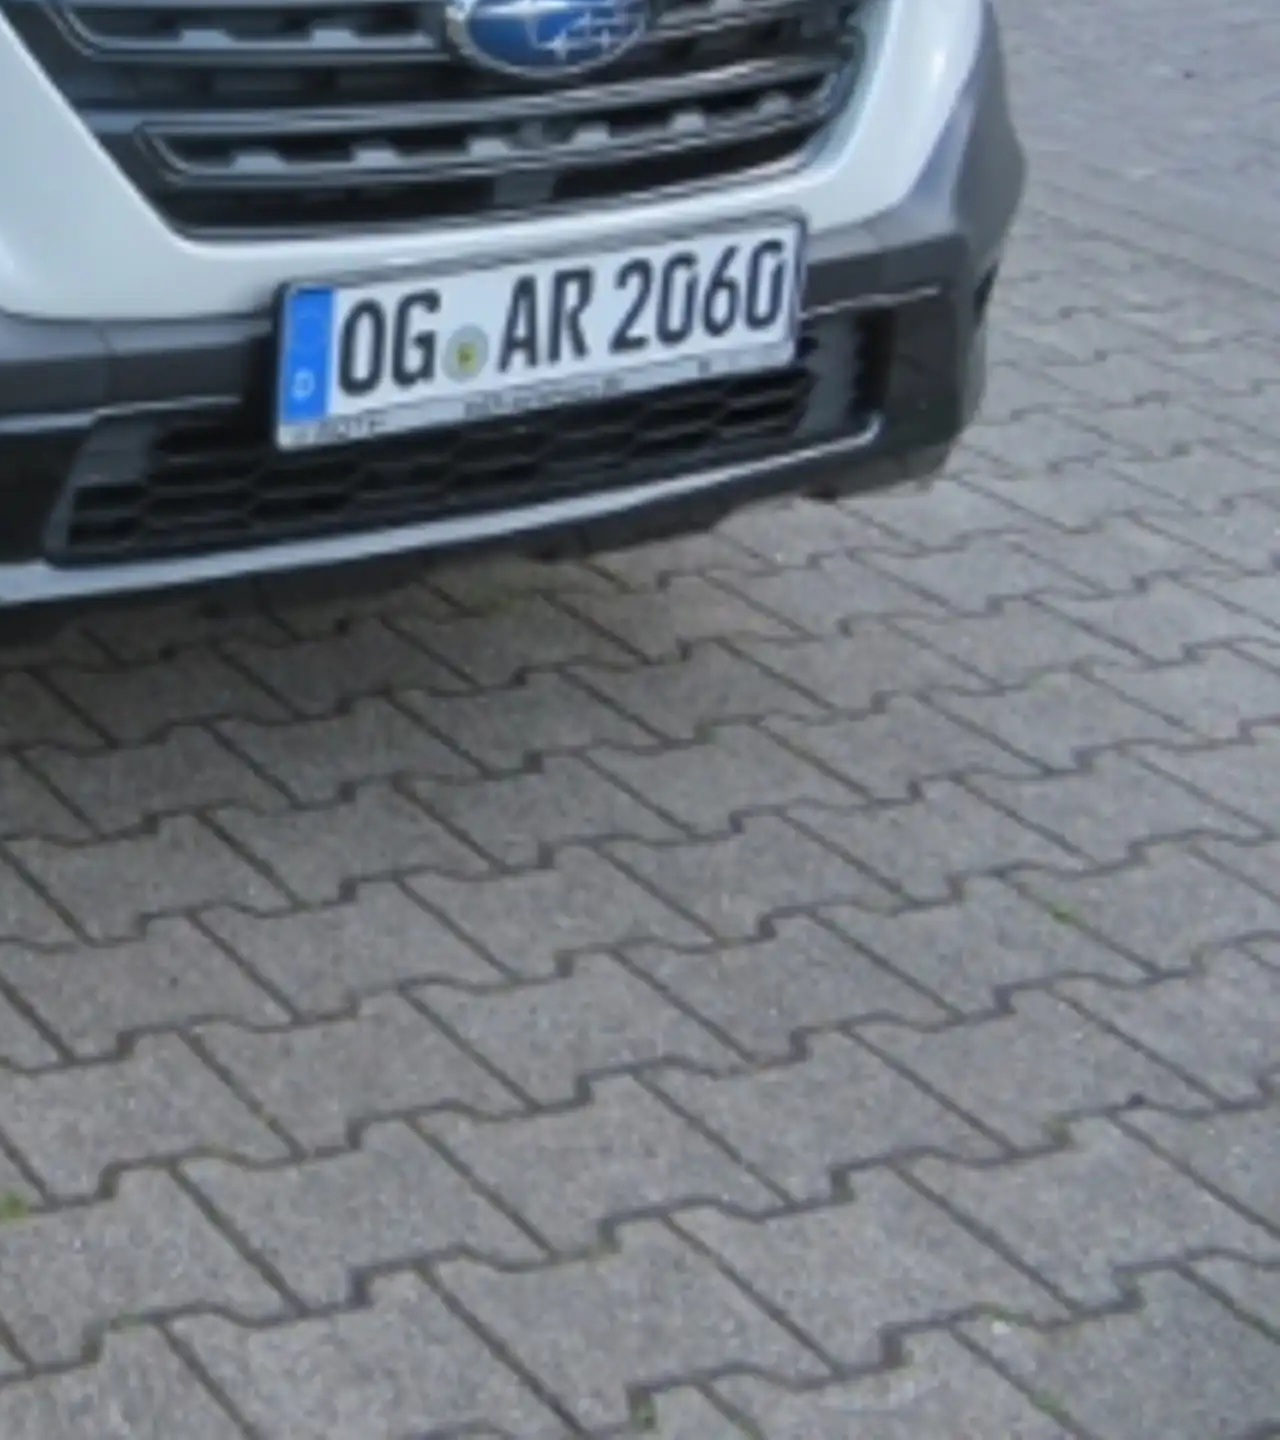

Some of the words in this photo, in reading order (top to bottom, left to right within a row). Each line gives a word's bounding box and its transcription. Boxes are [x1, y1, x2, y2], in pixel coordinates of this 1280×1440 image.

[338, 288, 441, 397] OG
[496, 266, 594, 374] AR
[607, 238, 785, 356] 2060
[291, 368, 316, 400] D
